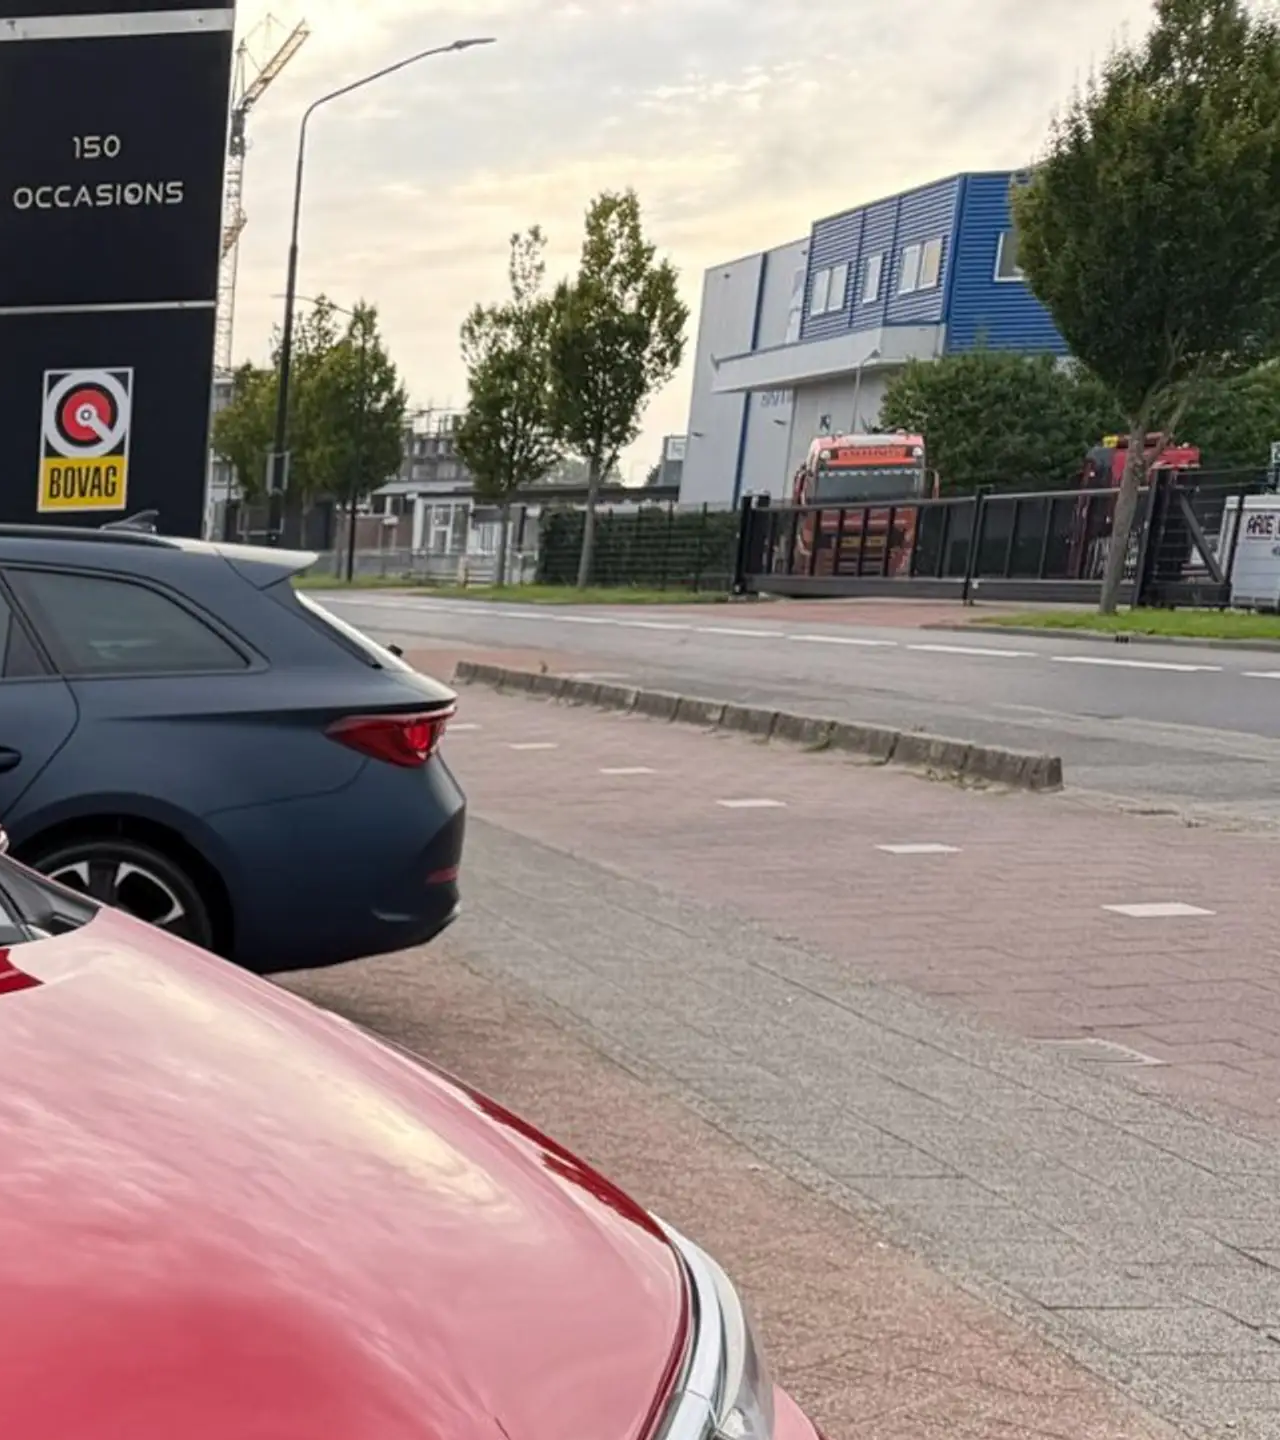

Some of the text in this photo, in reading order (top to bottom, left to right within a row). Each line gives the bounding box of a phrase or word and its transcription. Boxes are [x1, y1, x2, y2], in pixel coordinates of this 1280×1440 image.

[73, 134, 121, 159] 150
[13, 181, 184, 209] OCCASIONS
[48, 465, 118, 499] BOVAG
